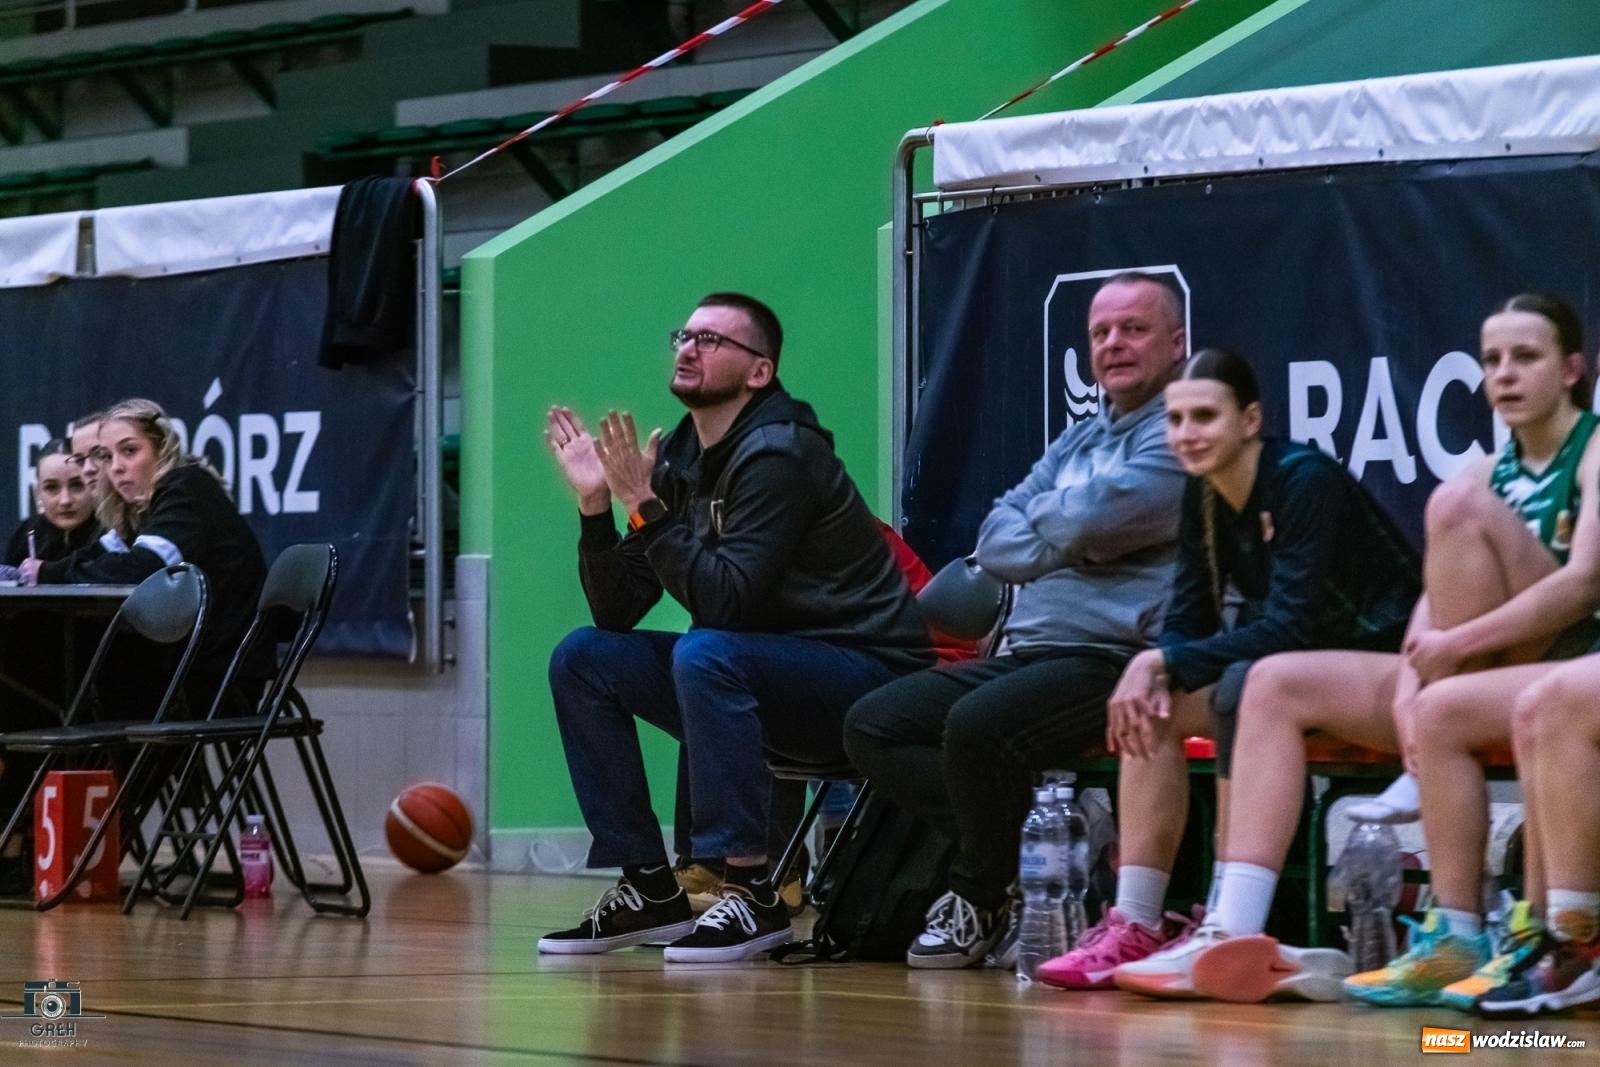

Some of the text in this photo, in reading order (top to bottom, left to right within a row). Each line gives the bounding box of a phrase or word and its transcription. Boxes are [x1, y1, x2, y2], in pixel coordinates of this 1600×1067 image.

[19, 377, 322, 521] RÓRZ
[1289, 352, 1600, 484] RAC
[37, 785, 58, 871] 5
[73, 785, 109, 871] 5
